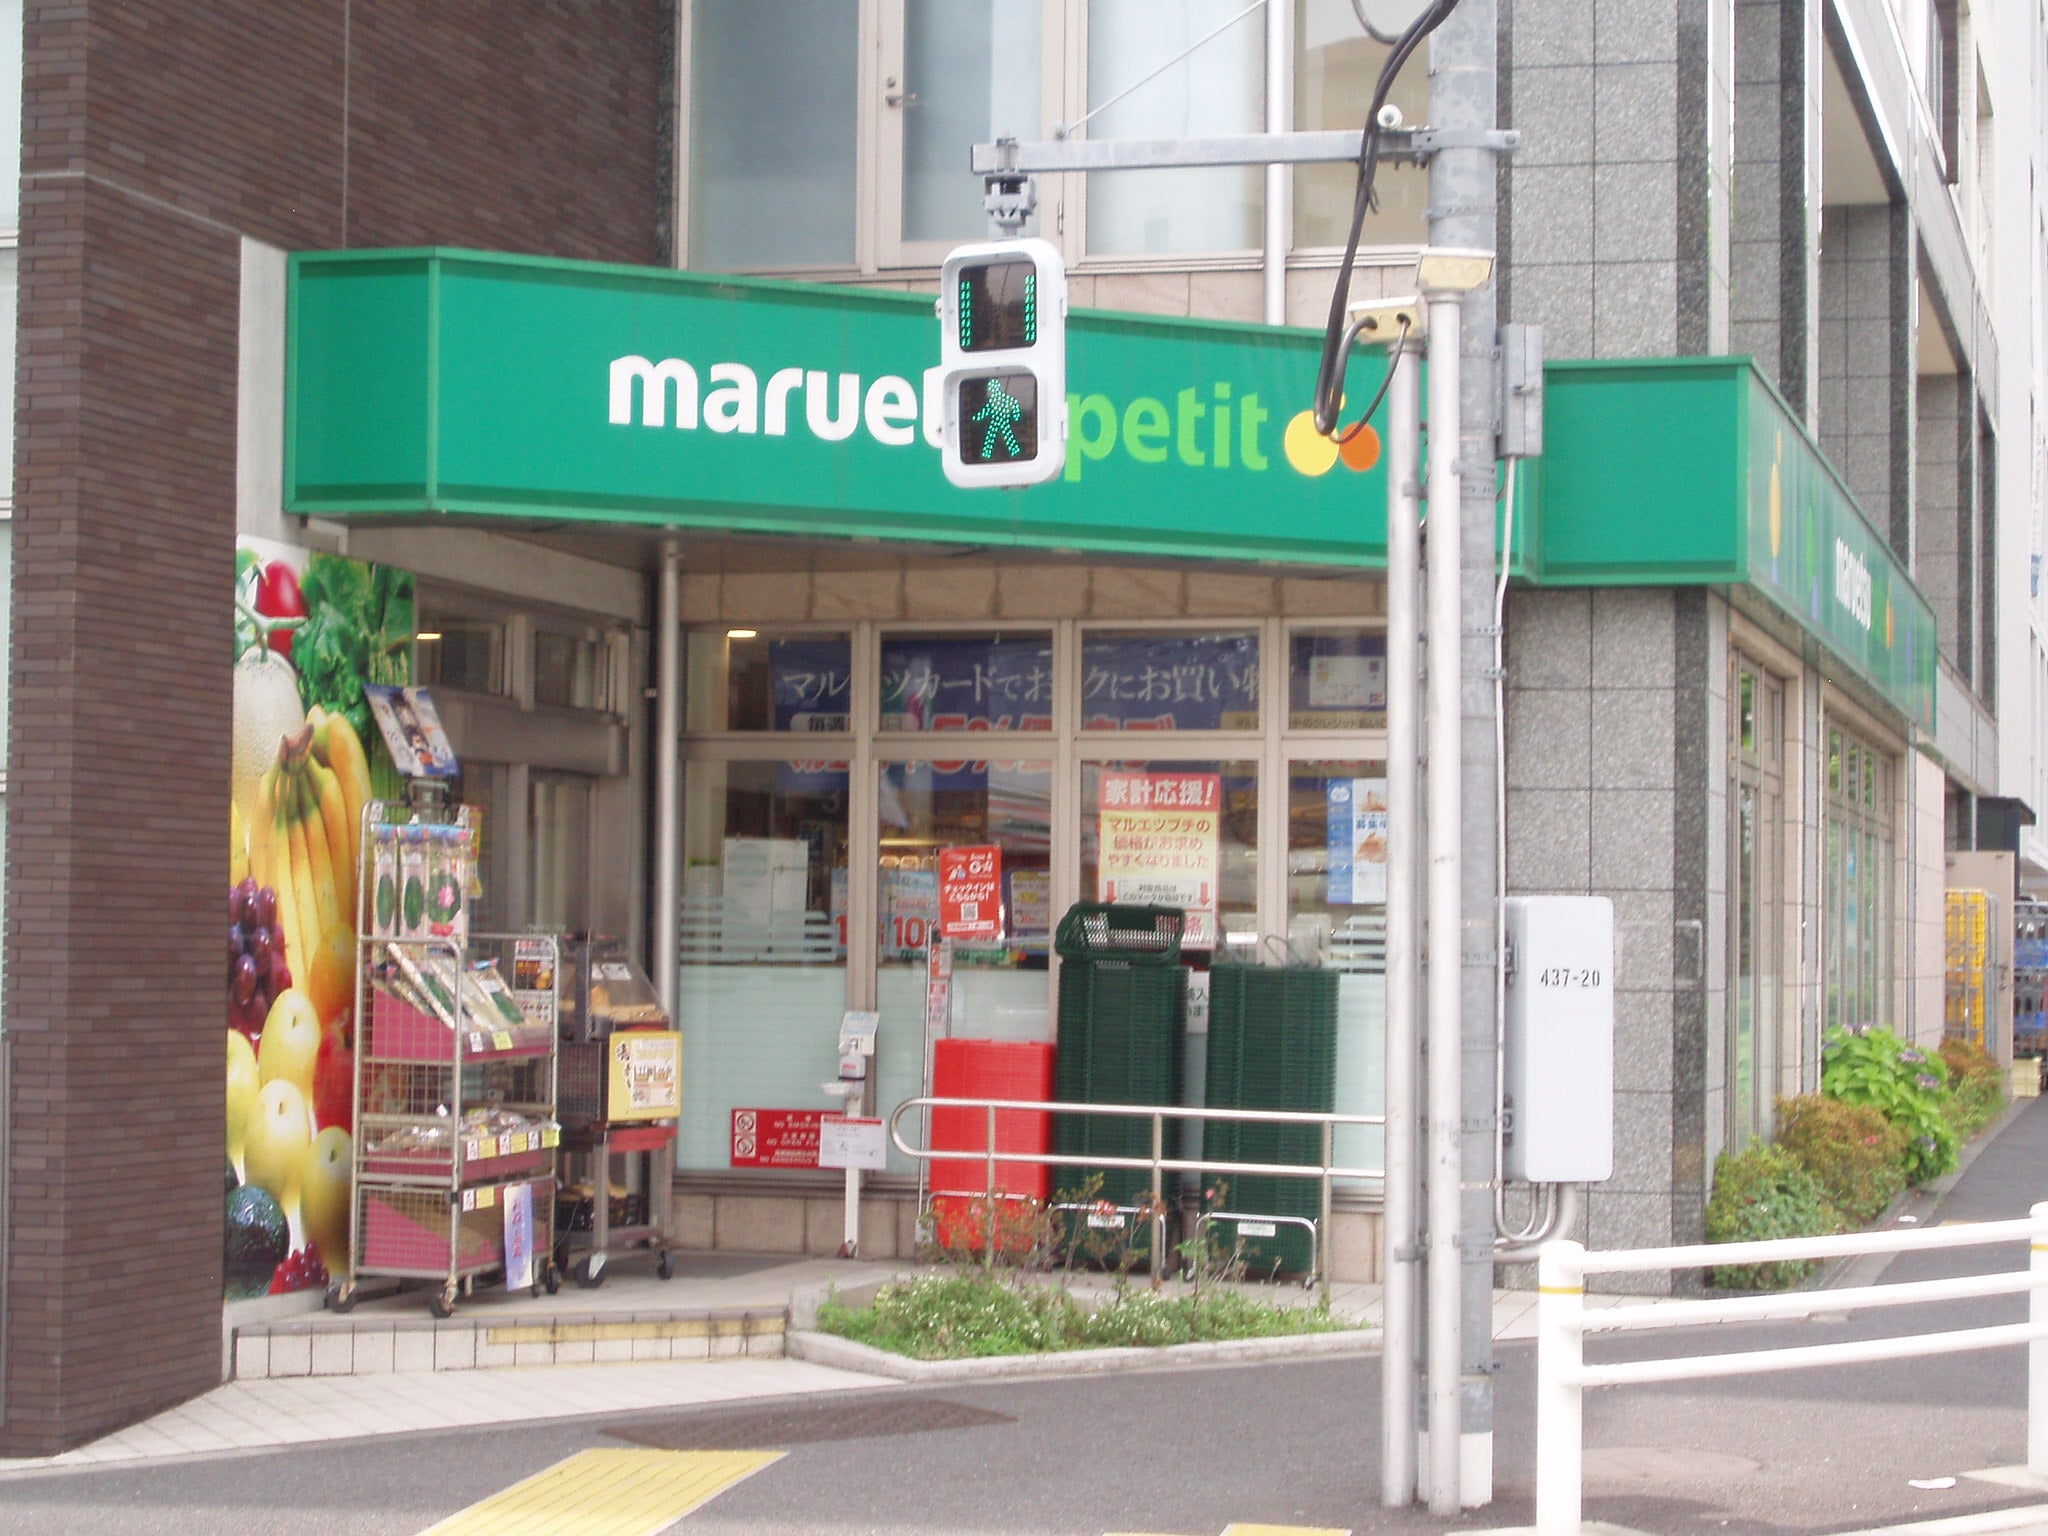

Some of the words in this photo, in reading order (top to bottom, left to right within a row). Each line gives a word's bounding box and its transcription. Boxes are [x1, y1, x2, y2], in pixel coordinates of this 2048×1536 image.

[1064, 381, 1269, 483] petit
[1104, 778, 1215, 806] 家計応援!
[1540, 968, 1600, 987] 437-20
